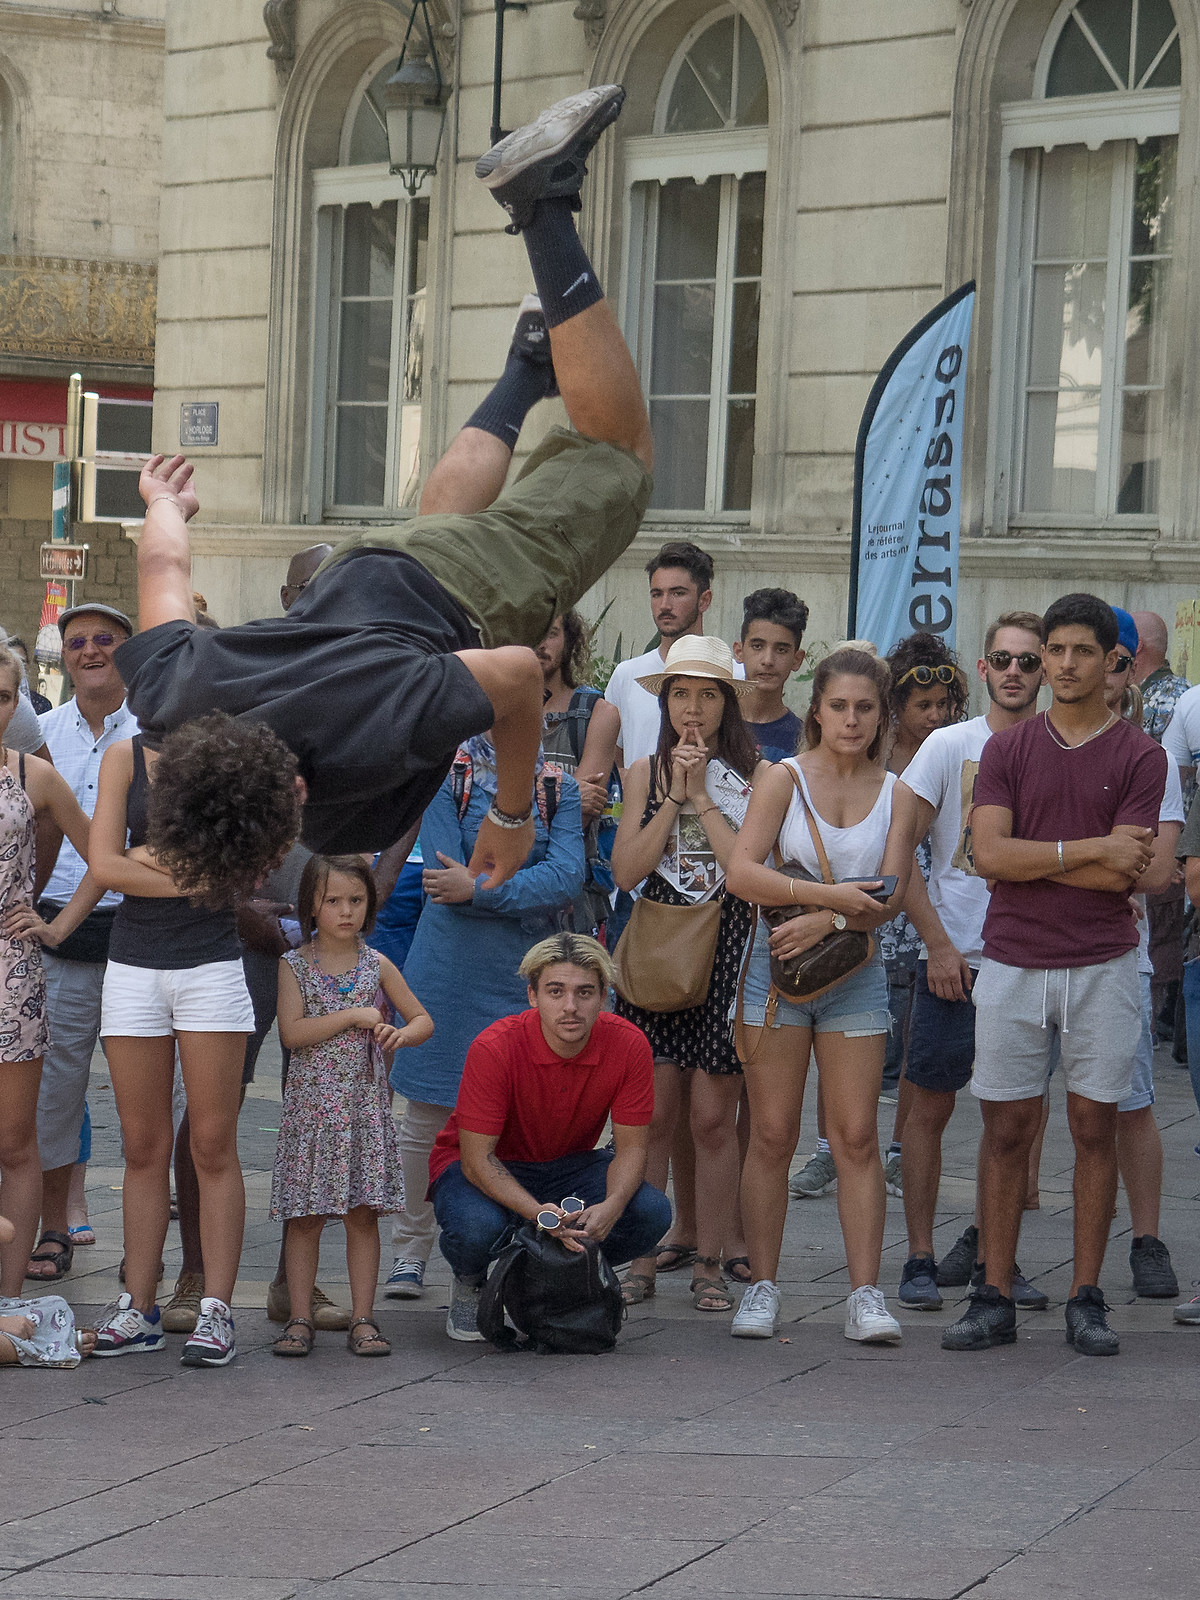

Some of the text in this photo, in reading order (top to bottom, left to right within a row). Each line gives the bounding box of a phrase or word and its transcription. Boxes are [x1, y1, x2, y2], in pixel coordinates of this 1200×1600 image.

[875, 520, 905, 535] journal
[876, 534, 904, 547] référe
[880, 548, 897, 559] arts
